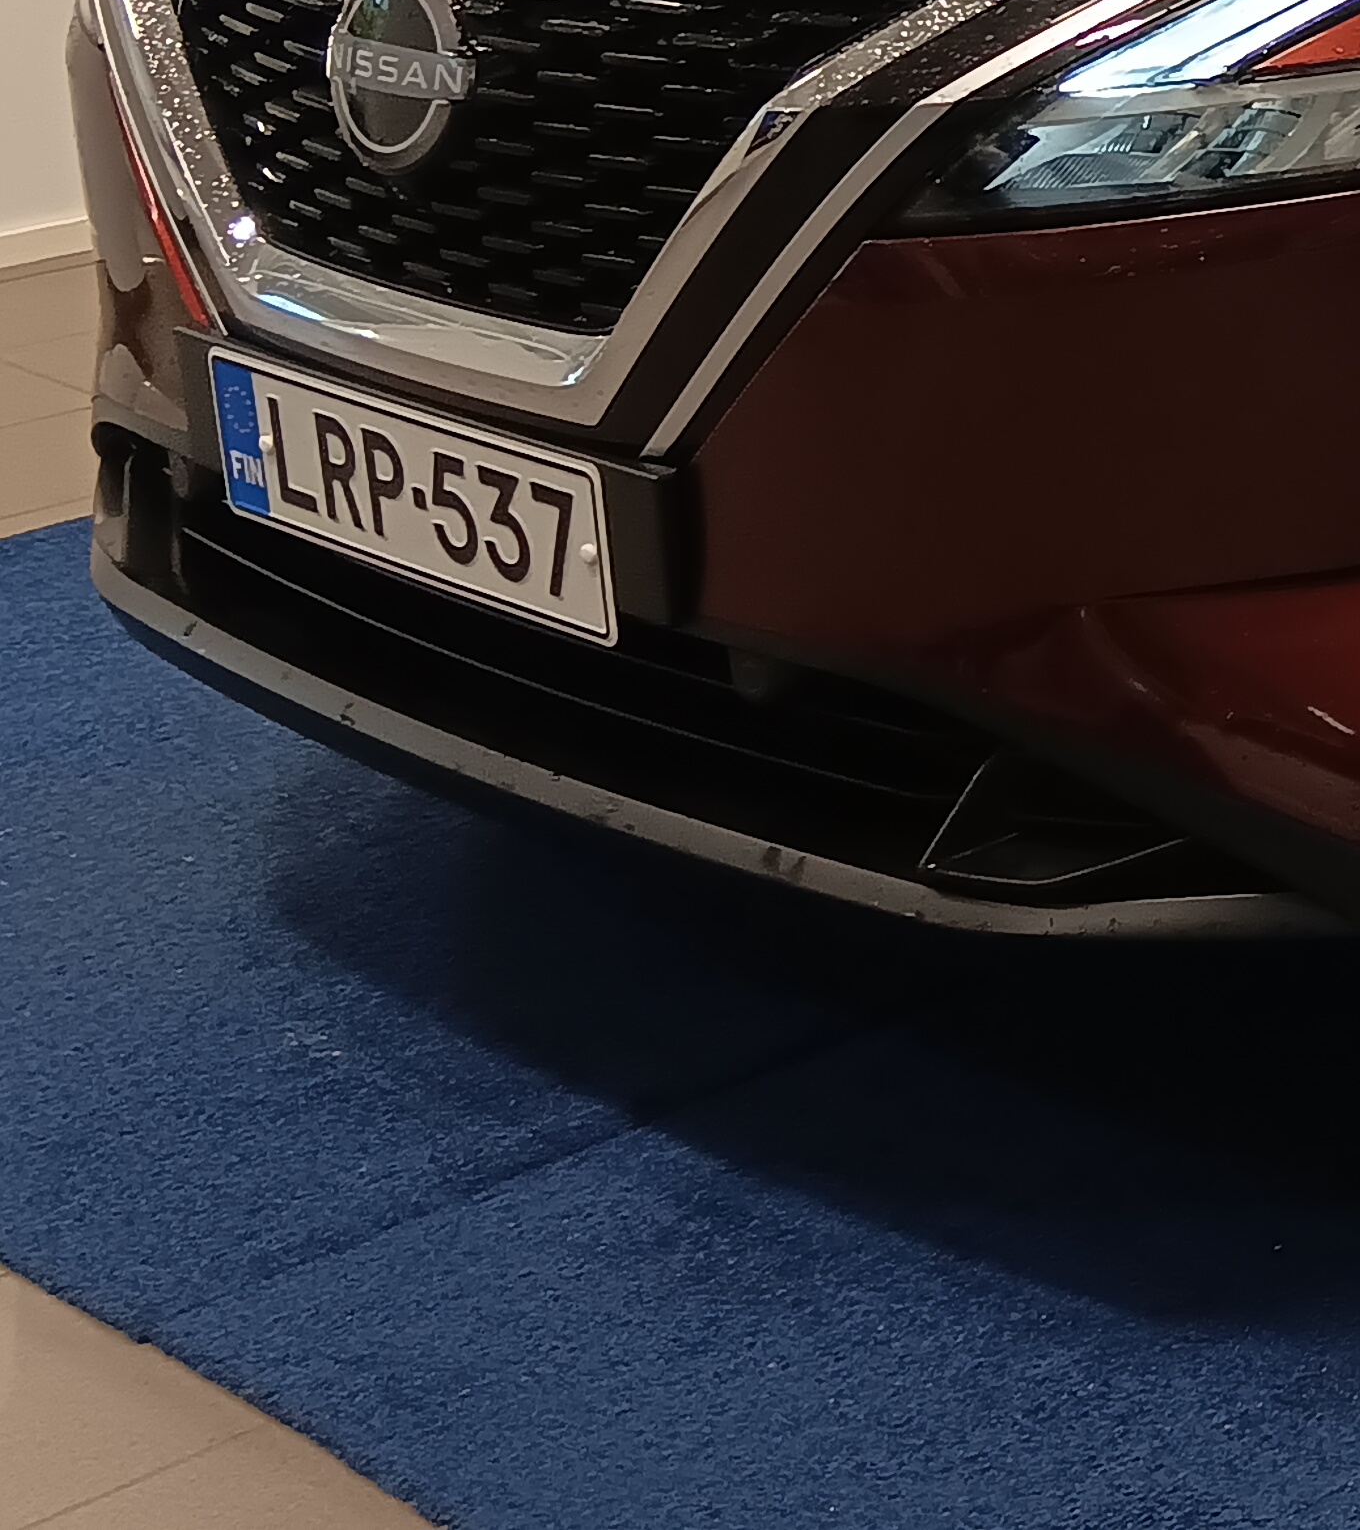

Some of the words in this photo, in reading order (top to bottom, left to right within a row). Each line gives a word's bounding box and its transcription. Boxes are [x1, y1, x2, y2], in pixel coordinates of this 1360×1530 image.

[334, 43, 463, 94] NISSAN
[230, 449, 265, 487] FIN
[266, 394, 575, 599] LRP-537
